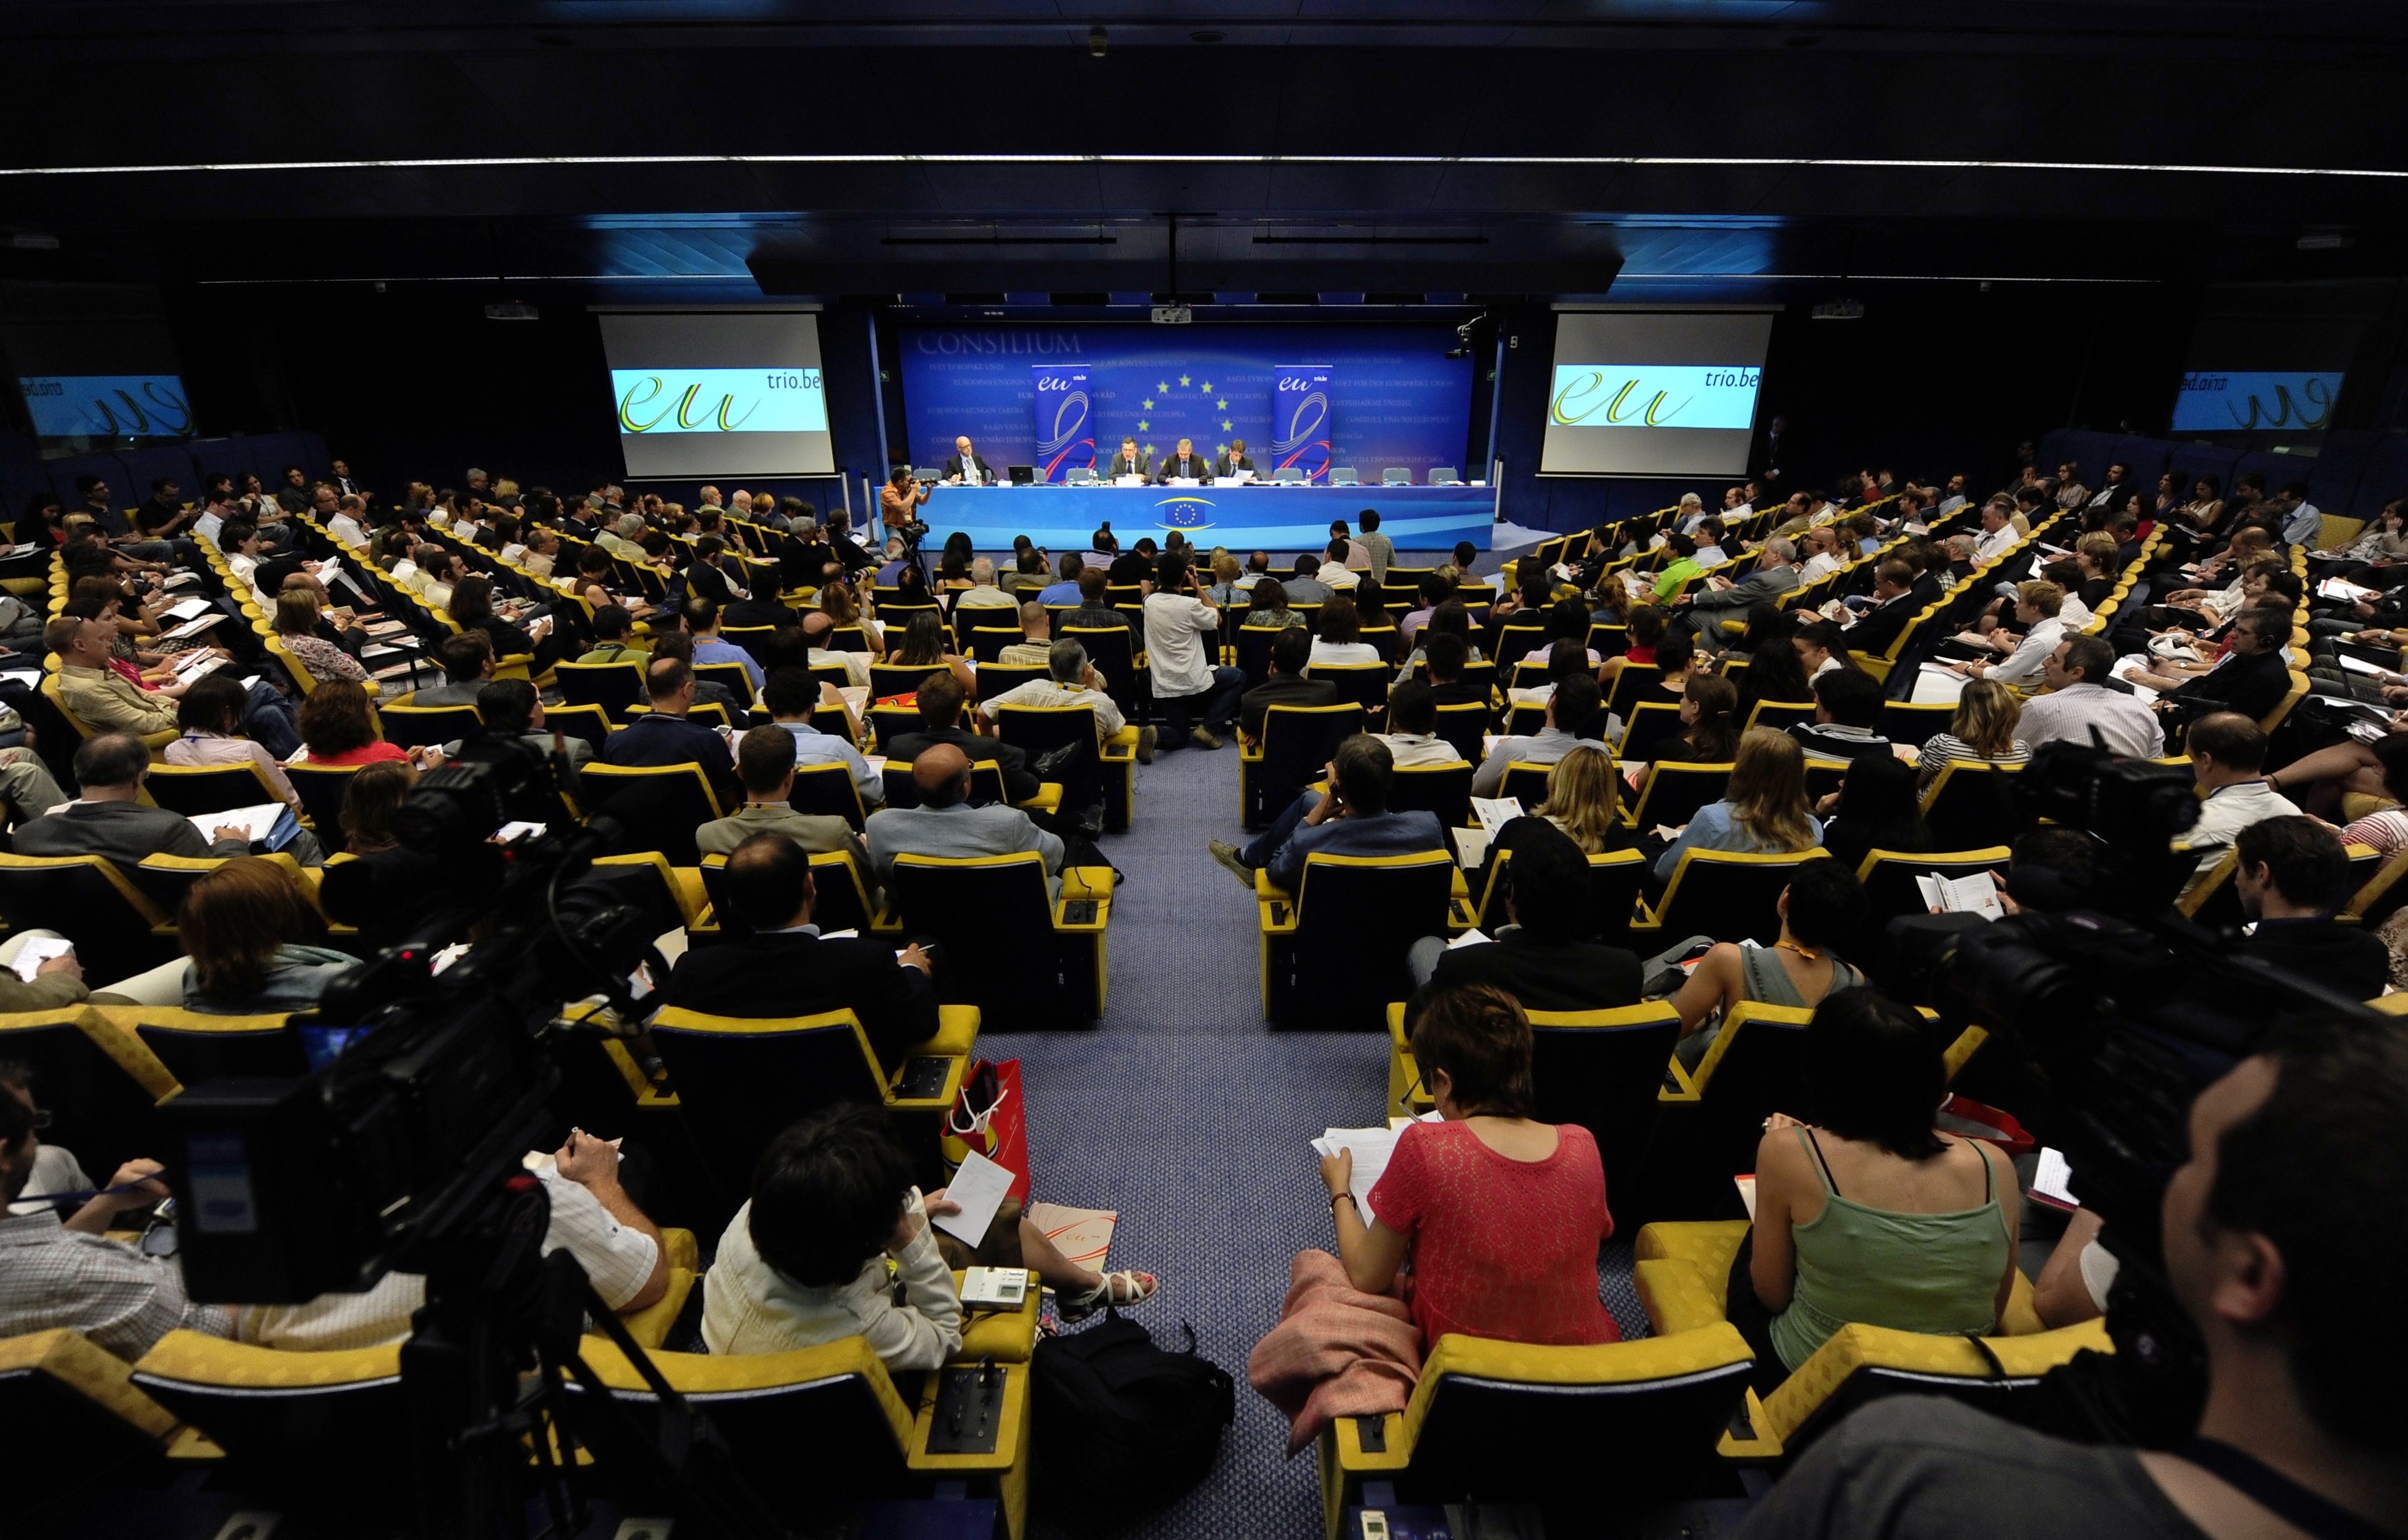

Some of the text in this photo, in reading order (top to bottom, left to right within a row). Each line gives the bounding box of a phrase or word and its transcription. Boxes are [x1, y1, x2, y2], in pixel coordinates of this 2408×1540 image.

[917, 333, 1081, 354] CONSILIUM
[1038, 376, 1072, 391] eu
[1279, 376, 1313, 391] eu
[616, 368, 821, 432] eu trio.be
[1553, 367, 1760, 426] eu trio.be
